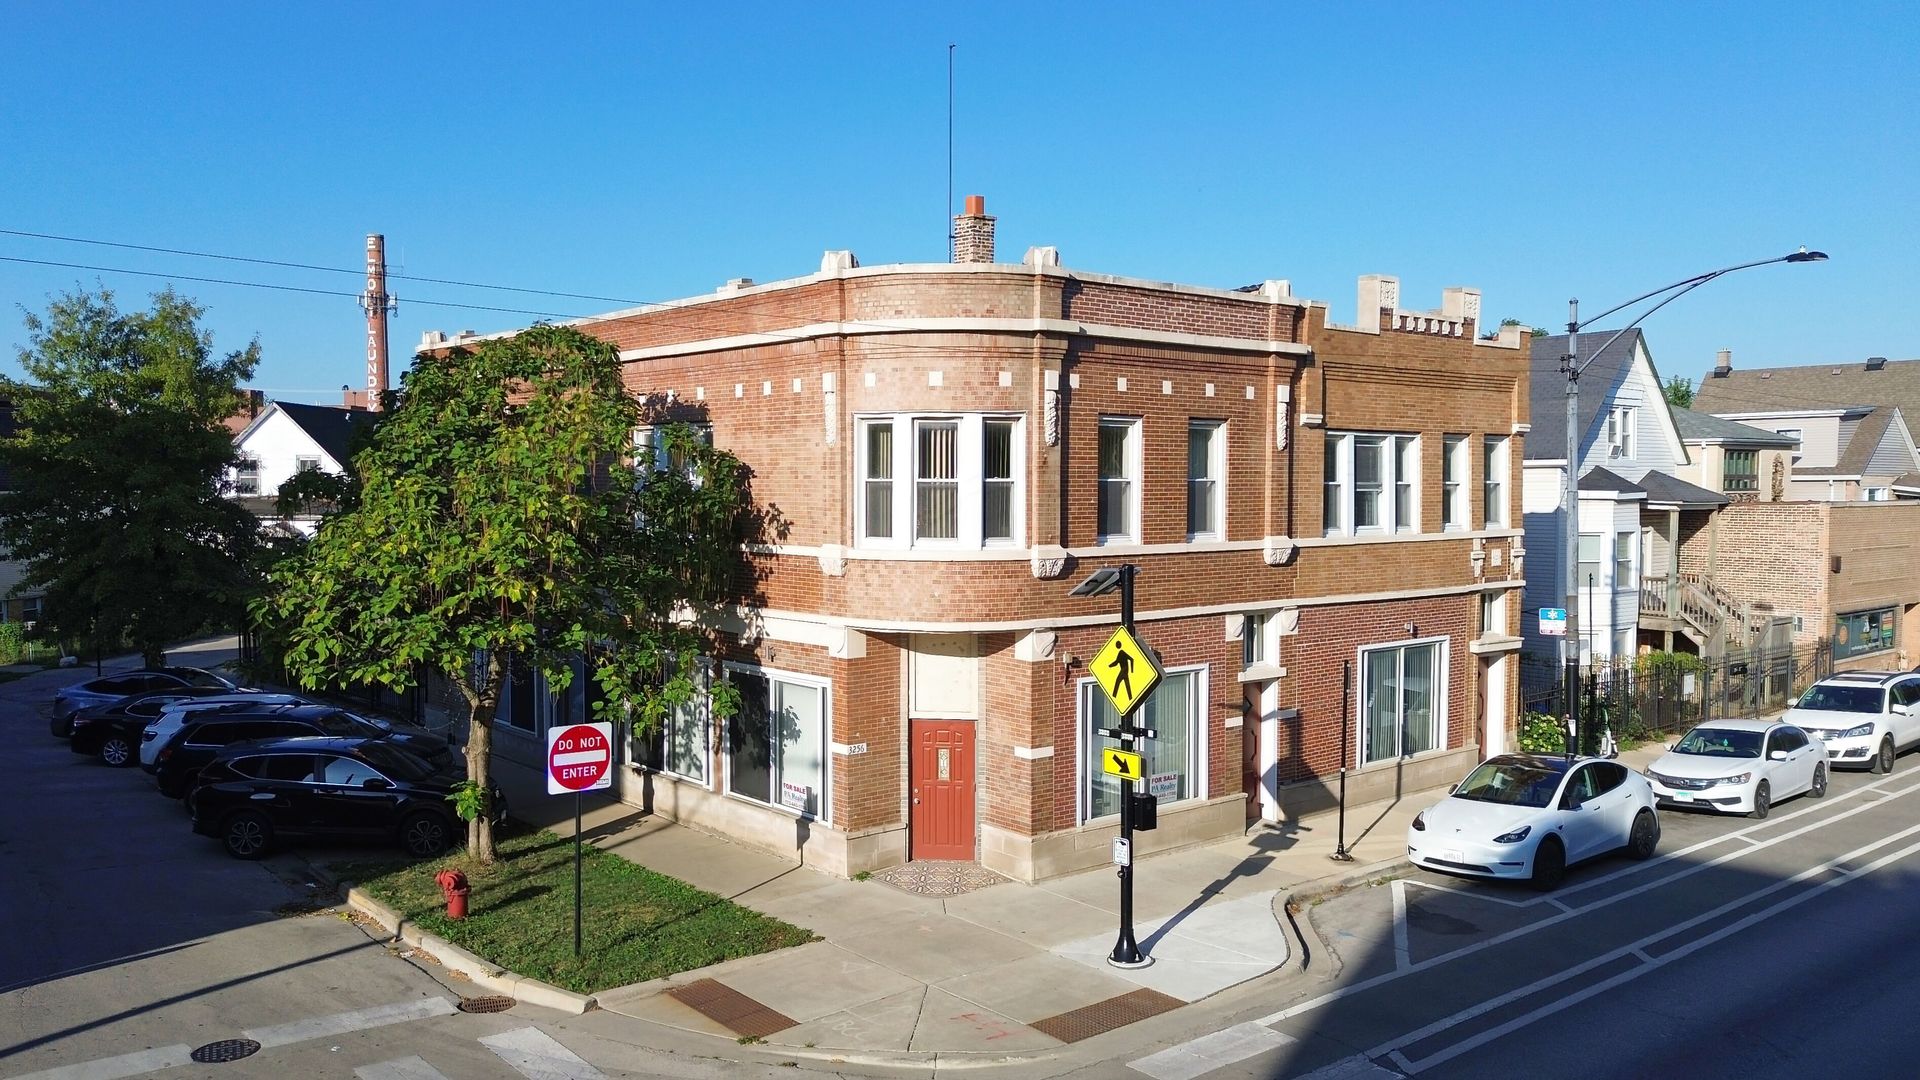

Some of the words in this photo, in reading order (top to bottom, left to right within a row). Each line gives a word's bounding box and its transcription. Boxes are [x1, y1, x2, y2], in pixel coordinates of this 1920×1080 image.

[367, 322, 378, 412] LAUNDRY
[558, 739, 573, 751] DO
[580, 736, 602, 749] NOT
[849, 744, 865, 755] 3256
[563, 765, 597, 779] ENTER
[1151, 776, 1162, 784] FOR
[1163, 774, 1177, 782] SALE
[783, 782, 793, 790] FOR
[793, 785, 806, 794] SALE
